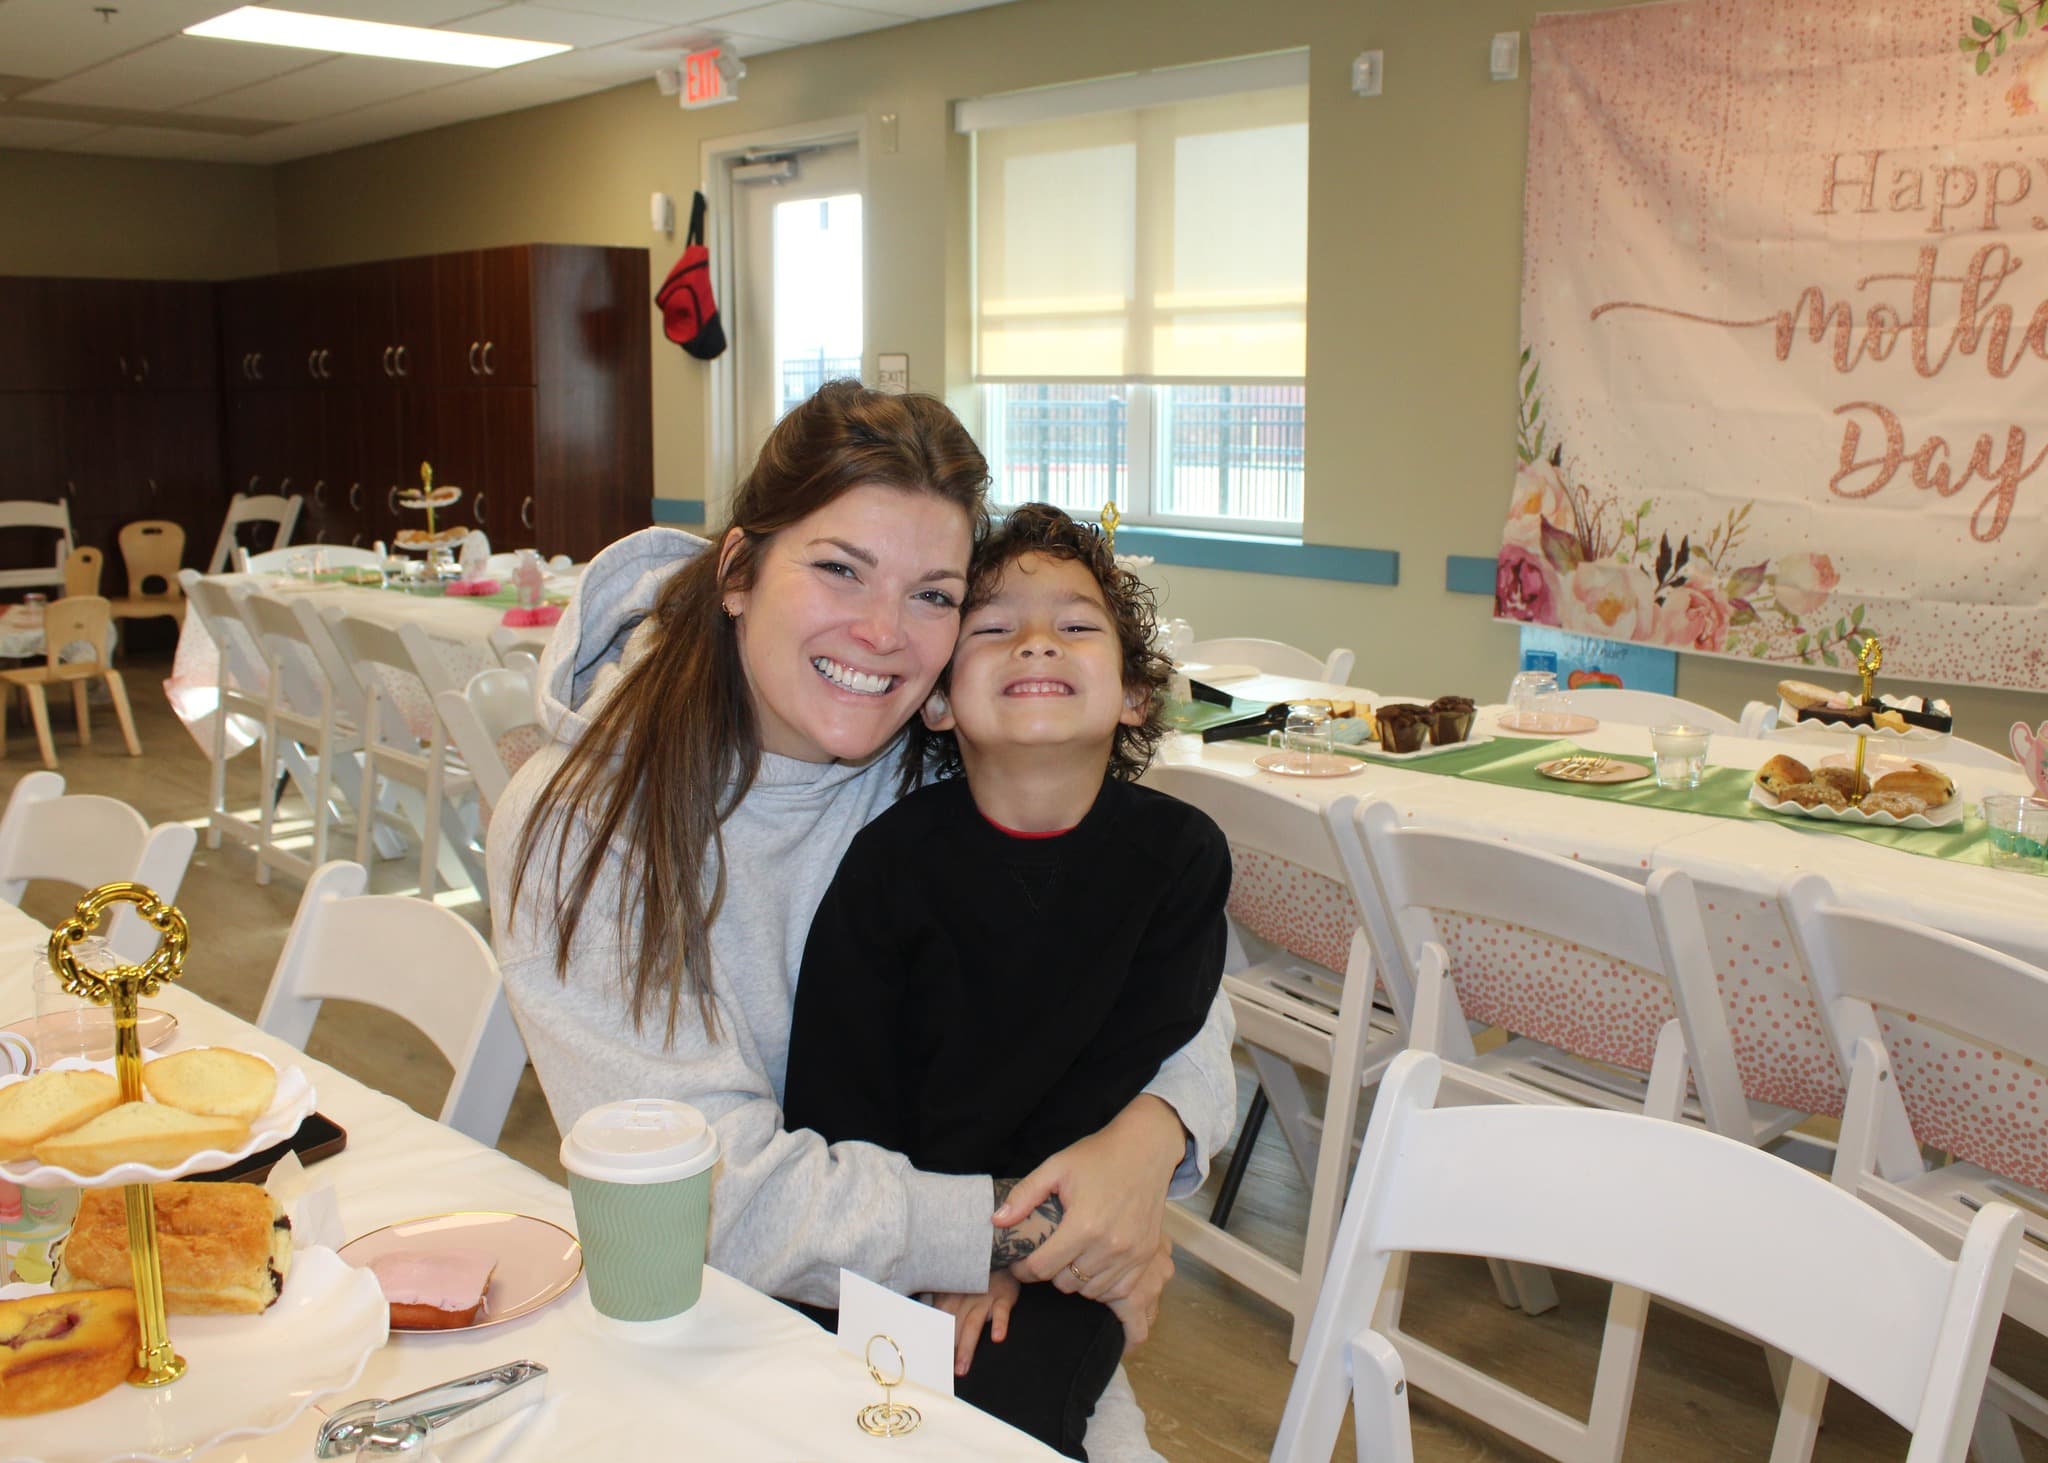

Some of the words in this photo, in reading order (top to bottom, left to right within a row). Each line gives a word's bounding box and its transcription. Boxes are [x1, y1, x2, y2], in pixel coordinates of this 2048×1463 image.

[687, 48, 720, 103] EXIT
[879, 369, 905, 383] EXIT
[1829, 401, 2048, 543] Day
